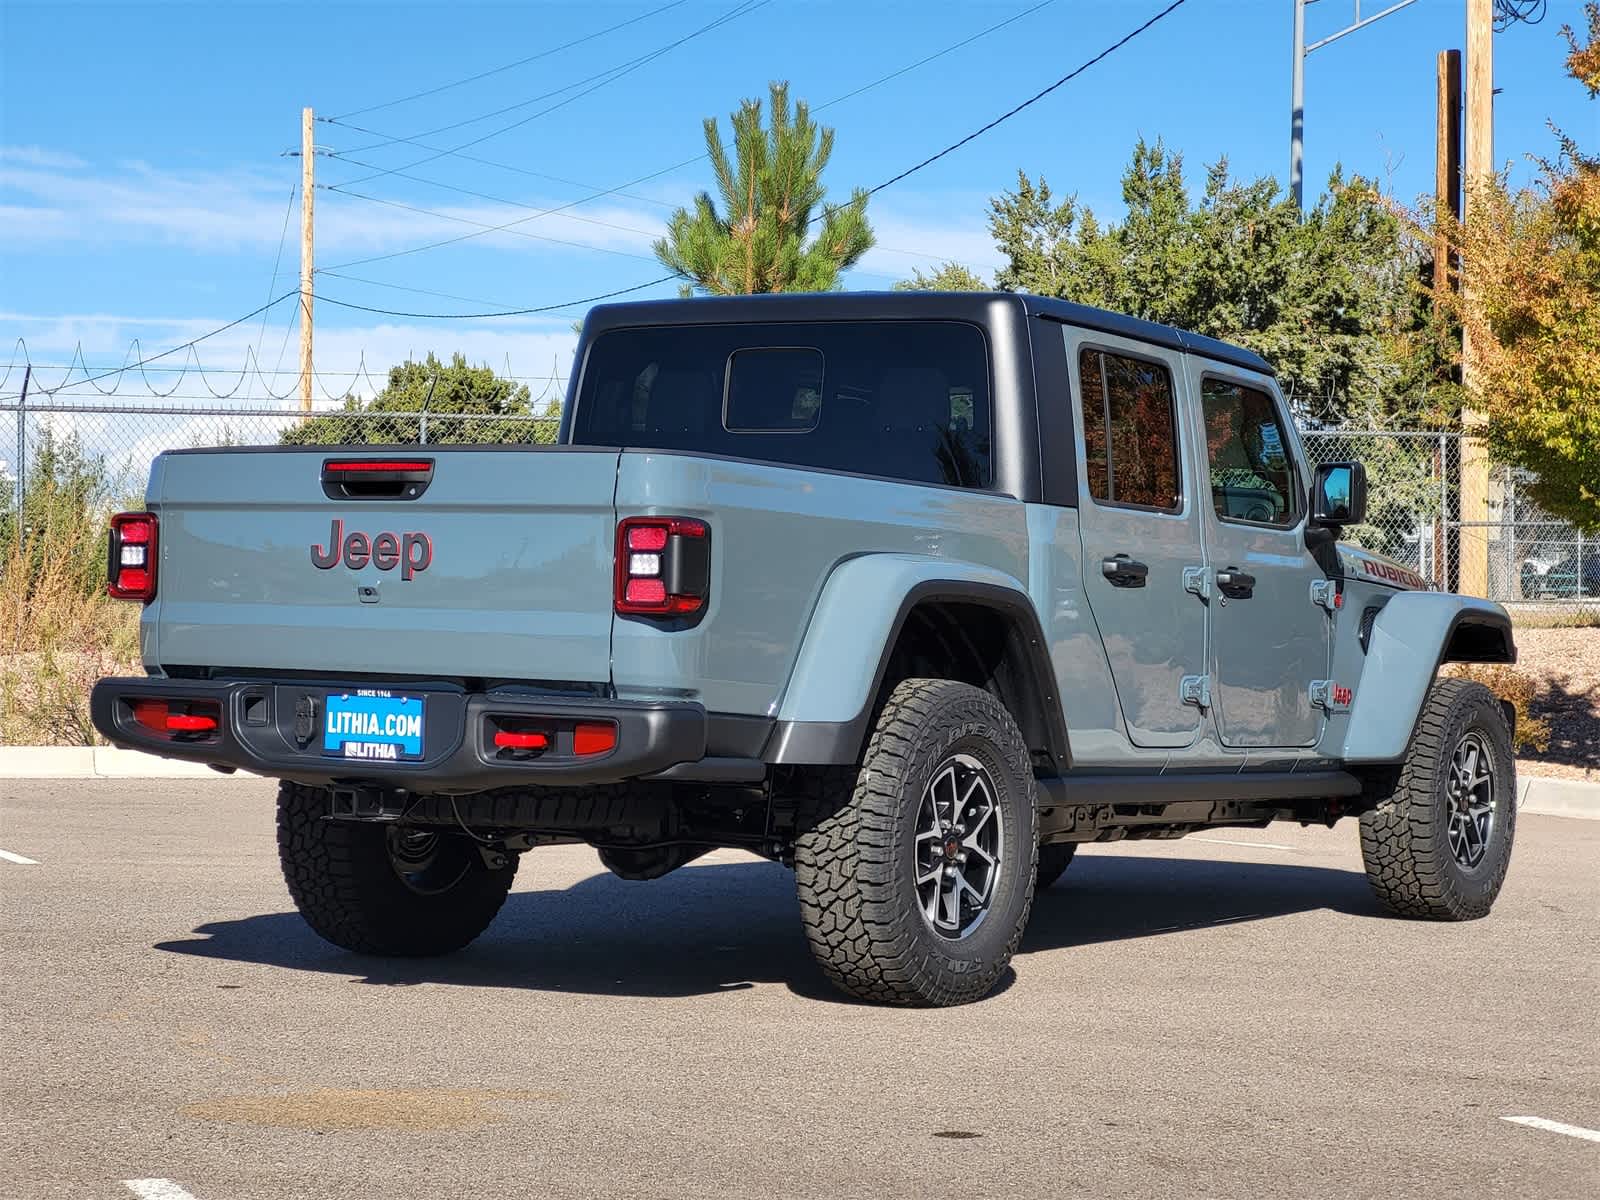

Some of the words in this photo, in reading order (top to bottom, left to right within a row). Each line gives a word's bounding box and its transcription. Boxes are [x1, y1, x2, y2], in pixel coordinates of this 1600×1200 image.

[310, 519, 432, 581] Jeep
[357, 689, 376, 697] SINCE
[327, 711, 421, 737] LITHIA.COM
[359, 742, 397, 759] LITHIA
